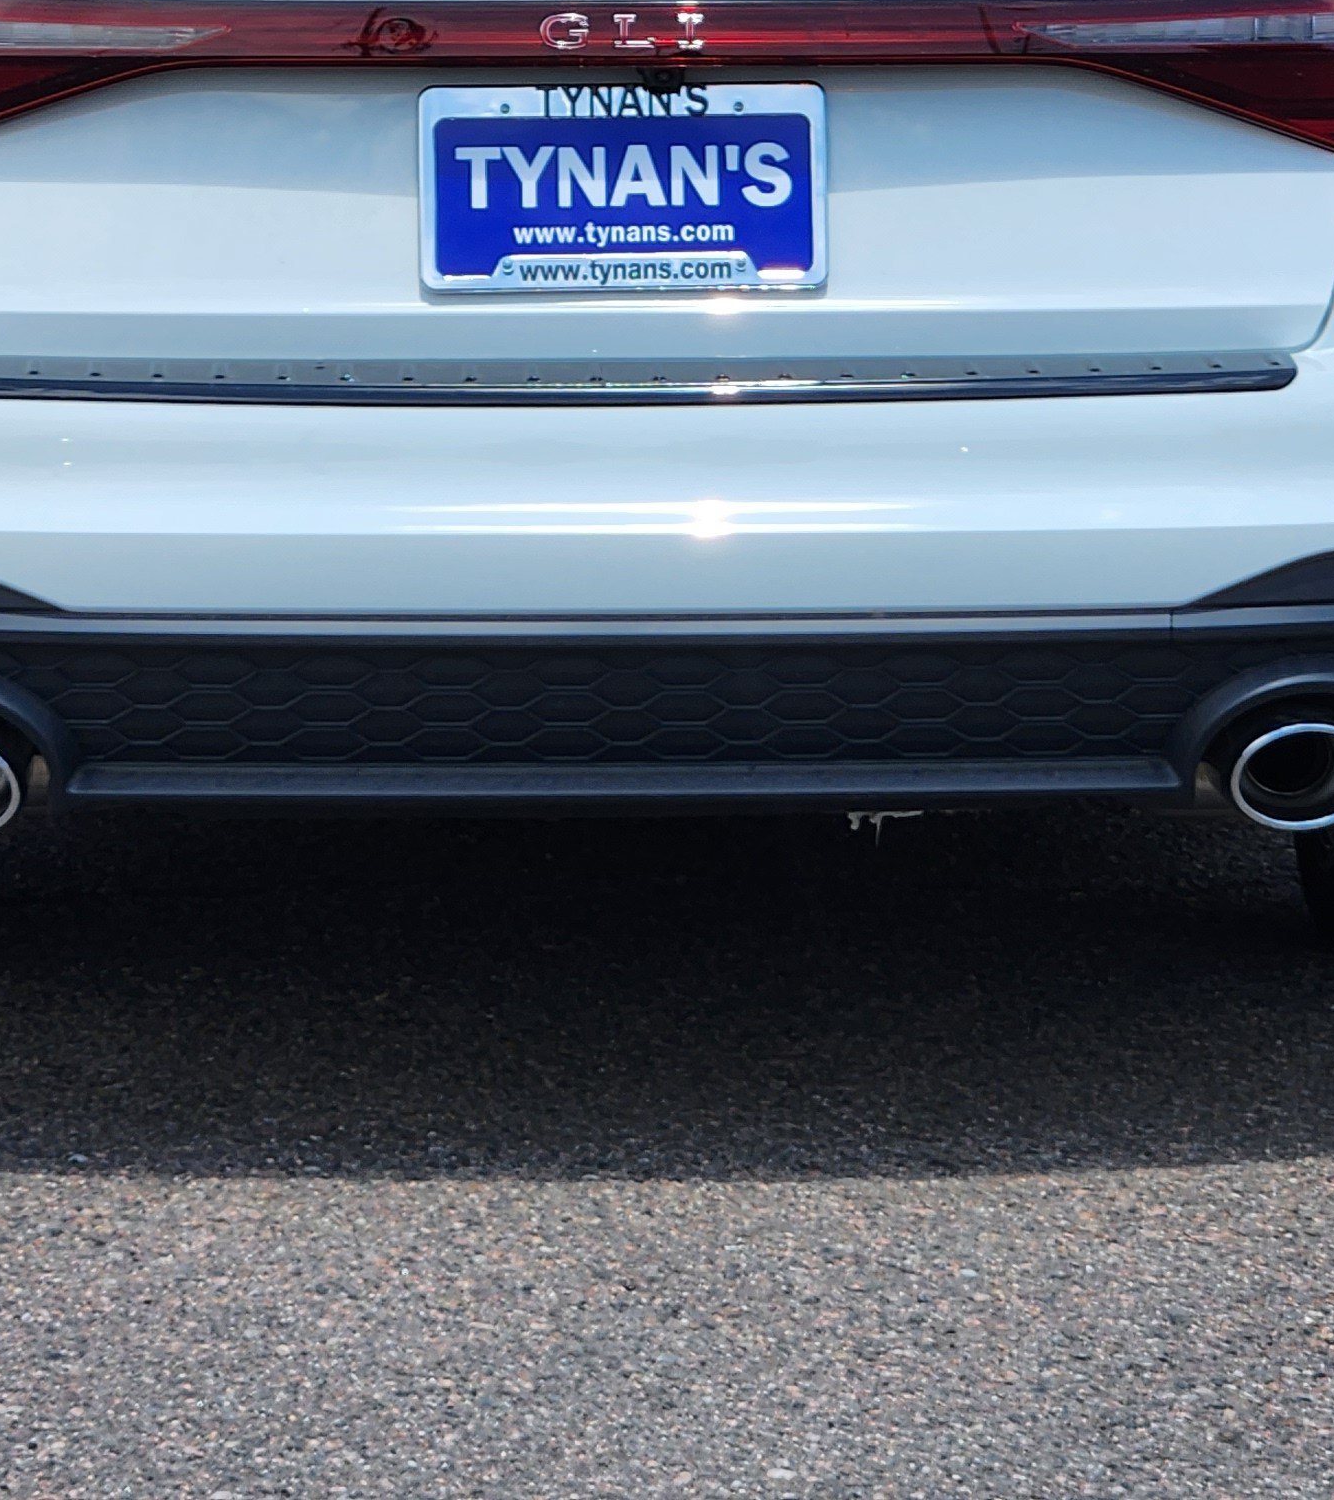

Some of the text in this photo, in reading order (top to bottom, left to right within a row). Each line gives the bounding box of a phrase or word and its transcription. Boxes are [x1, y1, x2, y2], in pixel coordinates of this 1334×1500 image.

[539, 12, 704, 50] GLI
[454, 142, 793, 208] TYNAN'S
[512, 221, 735, 248] www.tynans.com
[519, 257, 732, 285] www.tynans.com
